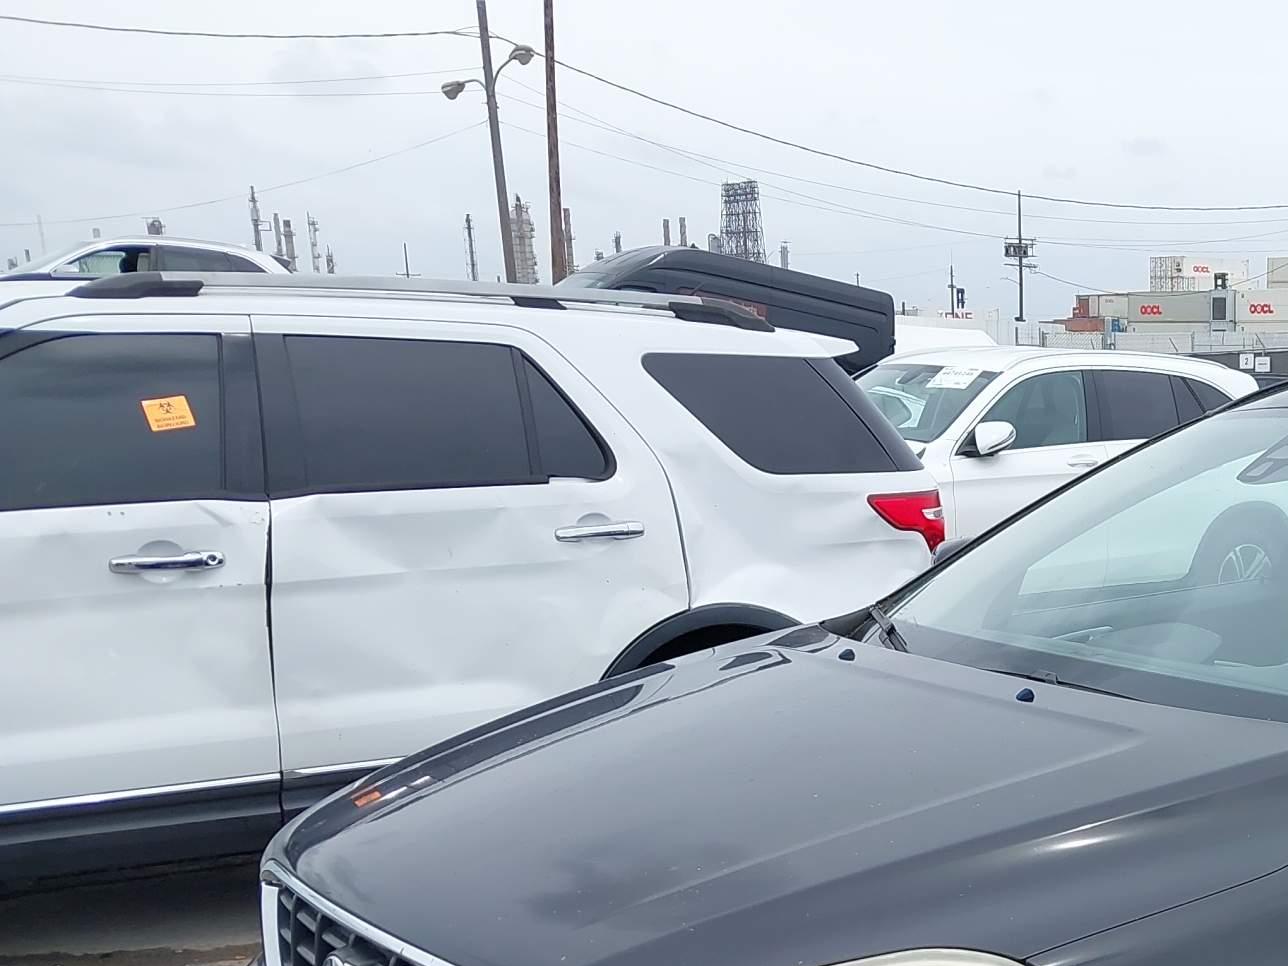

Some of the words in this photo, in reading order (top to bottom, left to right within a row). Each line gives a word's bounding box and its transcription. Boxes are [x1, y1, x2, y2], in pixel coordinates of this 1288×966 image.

[1193, 265, 1210, 273] OOCL
[1140, 305, 1162, 315] OOCL
[1249, 304, 1274, 314] OOCL
